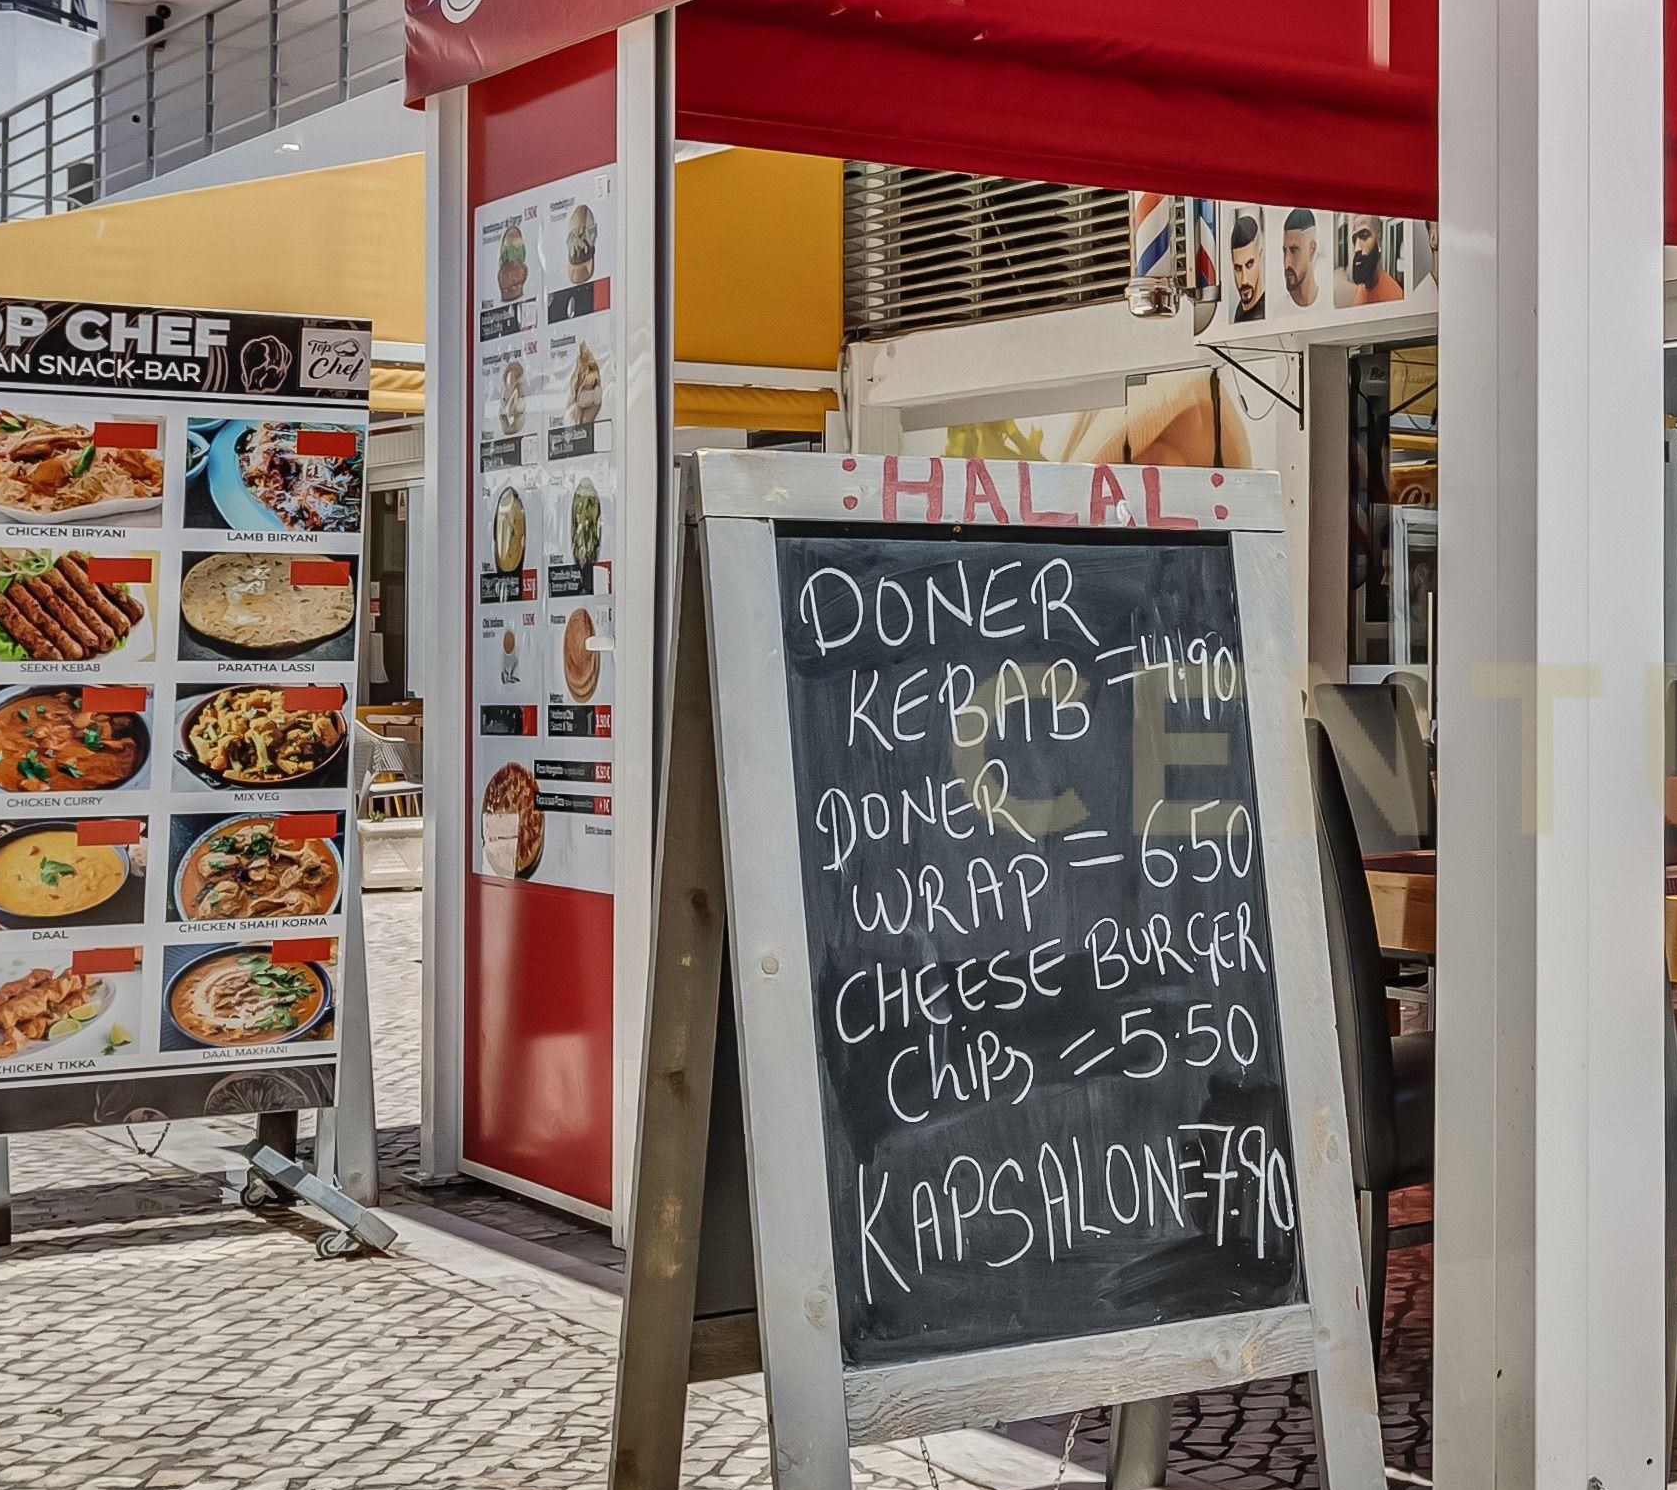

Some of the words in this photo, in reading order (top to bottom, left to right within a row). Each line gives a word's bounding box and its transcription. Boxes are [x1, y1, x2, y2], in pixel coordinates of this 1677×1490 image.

[65, 309, 231, 358] CHEF
[307, 339, 332, 356] Top
[38, 354, 202, 383] SNACK-BAR
[308, 355, 365, 382] Chef
[880, 455, 1199, 529] HALAL
[6, 526, 68, 538] CHICKEN
[72, 527, 127, 539] BIRYANI
[227, 531, 264, 542] LAMB
[267, 532, 319, 543] BIRYANI
[799, 557, 1100, 657] DONER
[20, 662, 59, 673] SEEKH
[61, 662, 101, 673] KEBAB
[217, 662, 278, 673] PARATHA
[281, 662, 315, 673] LASSI
[848, 658, 1092, 752] KEBAB
[6, 797, 61, 808] CHICKEN
[64, 796, 103, 806] CURRY
[234, 792, 256, 802] MIX
[258, 792, 280, 802] VEG
[816, 758, 1036, 871] DONER
[852, 853, 1050, 937] WRAP
[178, 921, 236, 933] CHICKEN
[239, 919, 279, 930] SHAHI
[282, 917, 328, 929] KORMA
[32, 930, 69, 941] DAAL
[833, 938, 1067, 1045] CHEESE
[1084, 901, 1267, 992] BURGER
[202, 1048, 232, 1060] DAAL
[235, 1045, 288, 1058] MAKHANI
[57, 1059, 96, 1070] TIKKA
